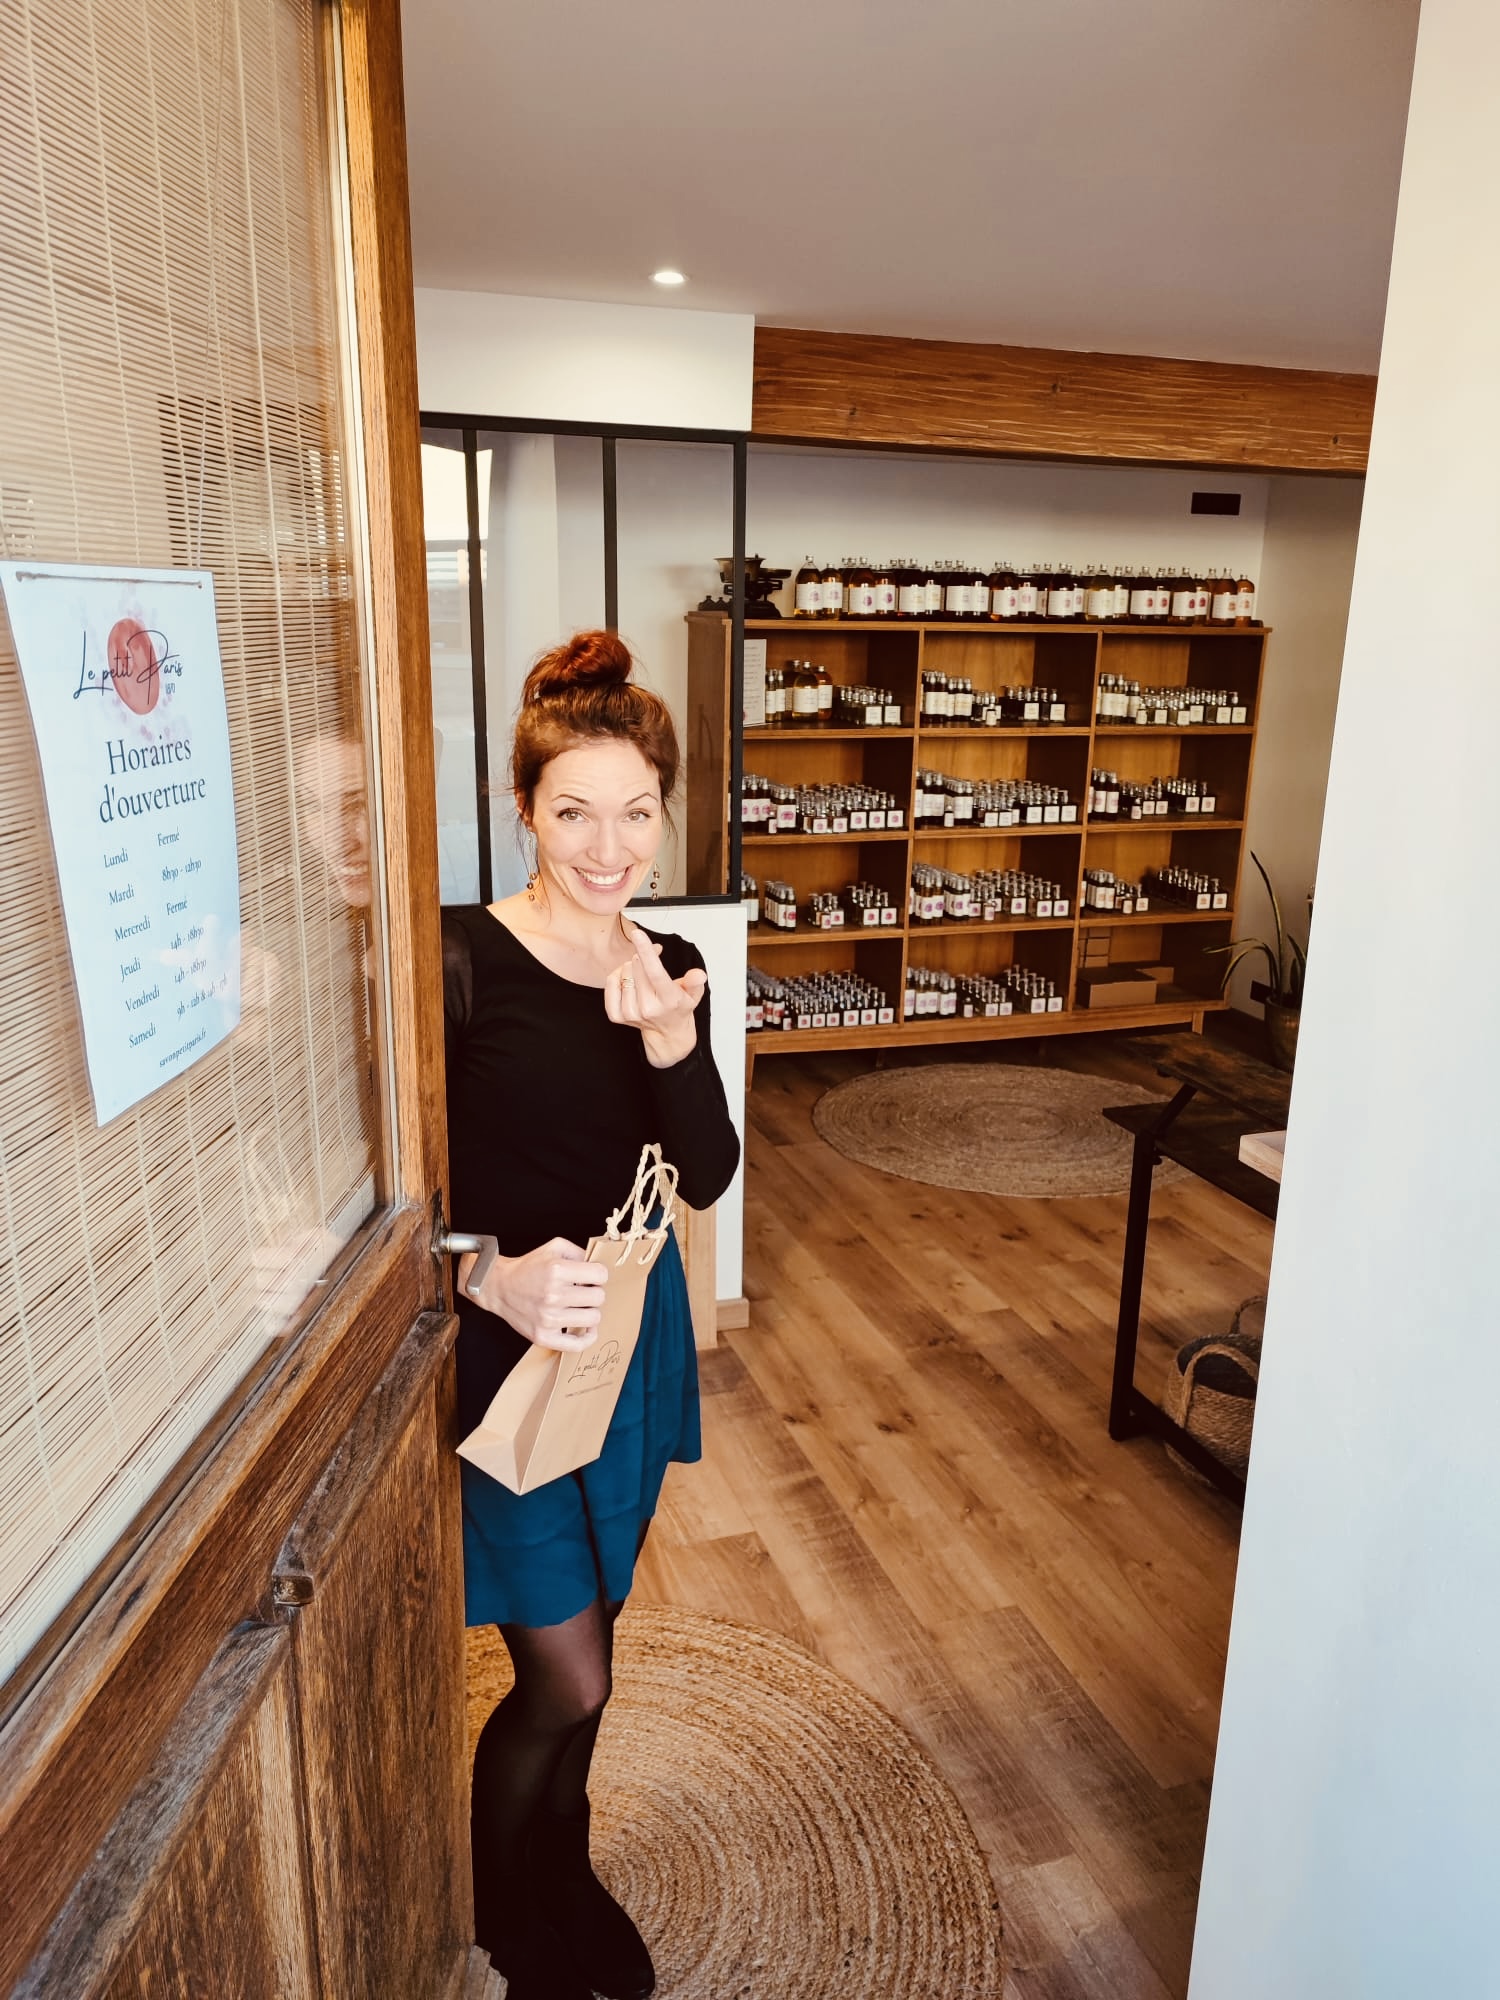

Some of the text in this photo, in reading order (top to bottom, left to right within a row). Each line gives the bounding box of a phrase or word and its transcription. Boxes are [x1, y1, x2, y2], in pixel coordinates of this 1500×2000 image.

[73, 630, 183, 705] Le petit Paris
[106, 735, 192, 775] Horaires
[100, 777, 206, 823] d'ouverture
[103, 826, 180, 868] Lundi Fermé
[109, 883, 135, 905] Mardi
[161, 866, 179, 882] 8h30
[185, 857, 201, 873] 12h30
[114, 896, 188, 942] Mercredi Fermé
[120, 956, 142, 983] Jeudi
[125, 984, 160, 1012] Vendredi
[128, 1021, 157, 1048] Samedi
